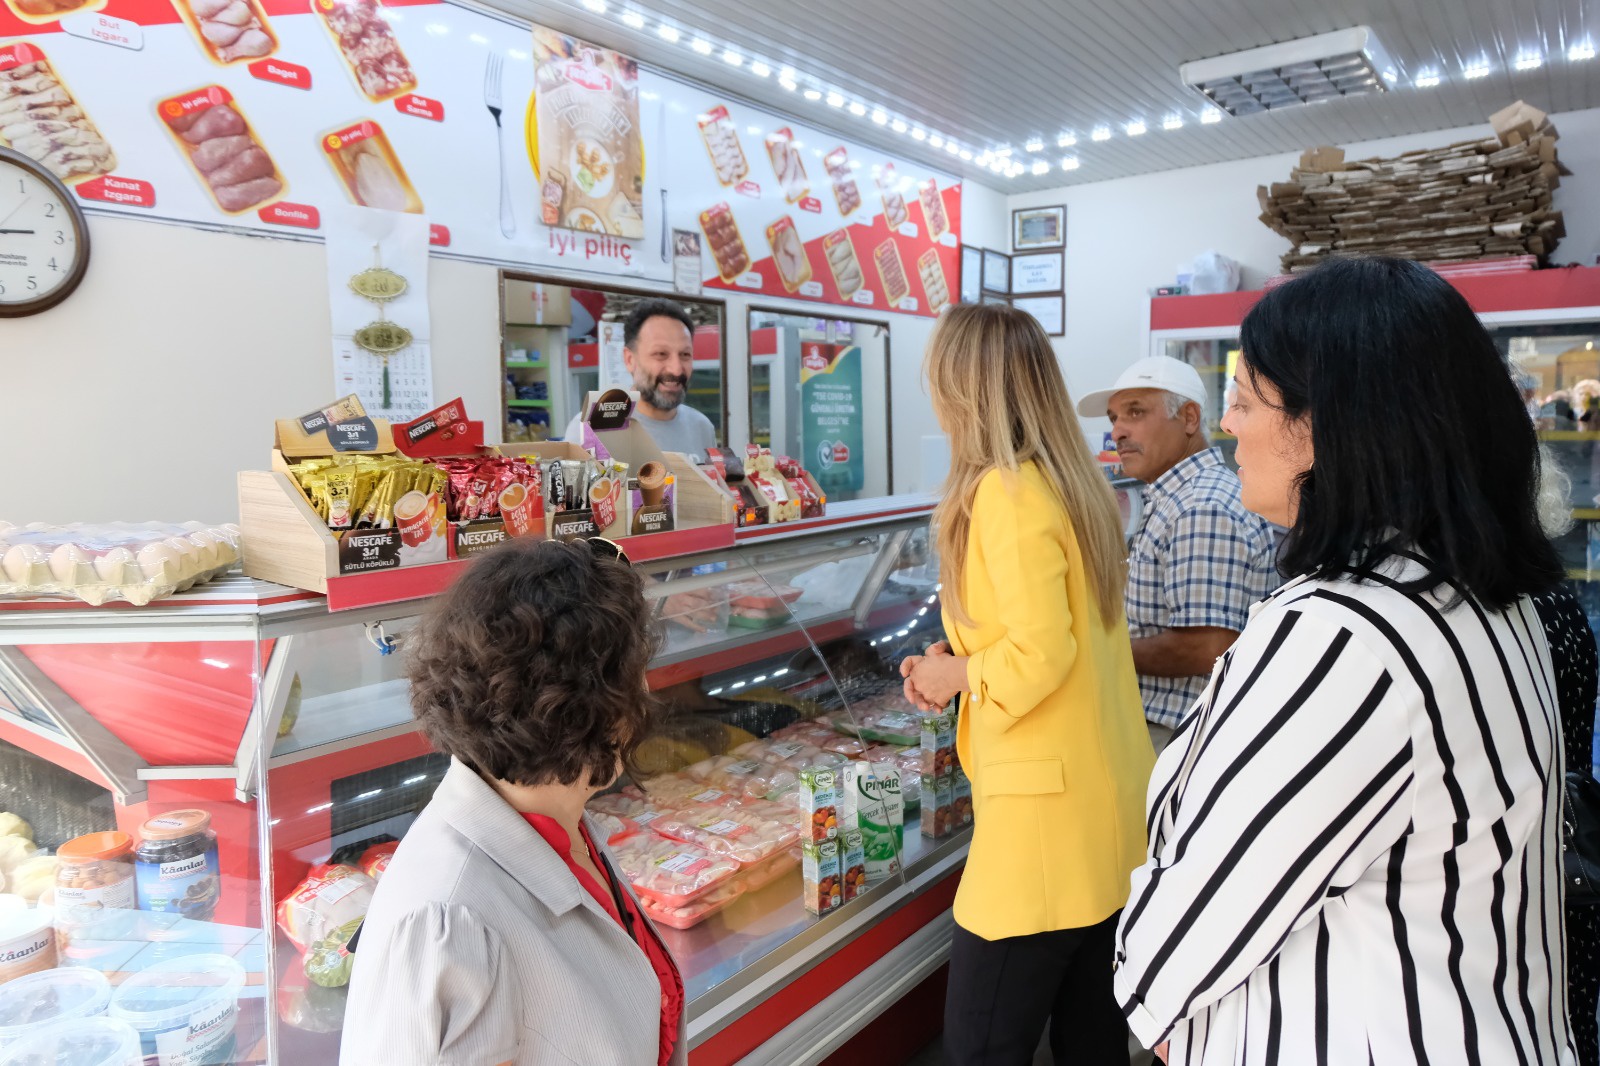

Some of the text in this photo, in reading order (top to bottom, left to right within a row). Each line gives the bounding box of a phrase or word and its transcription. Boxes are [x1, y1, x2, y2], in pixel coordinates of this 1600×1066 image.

[99, 18, 120, 30] But
[267, 65, 298, 79] Baget
[18, 179, 26, 194] 1
[104, 178, 140, 191] Kanat
[44, 202, 55, 218] 2
[274, 208, 310, 221] Bonfile
[53, 230, 65, 245] 3
[549, 227, 631, 266] iyi piliç
[47, 257, 59, 271] 4
[26, 275, 37, 290] 5
[344, 559, 394, 571] SÜTLÜ KÖPÜKLÜ
[161, 859, 205, 875] Kâanlar
